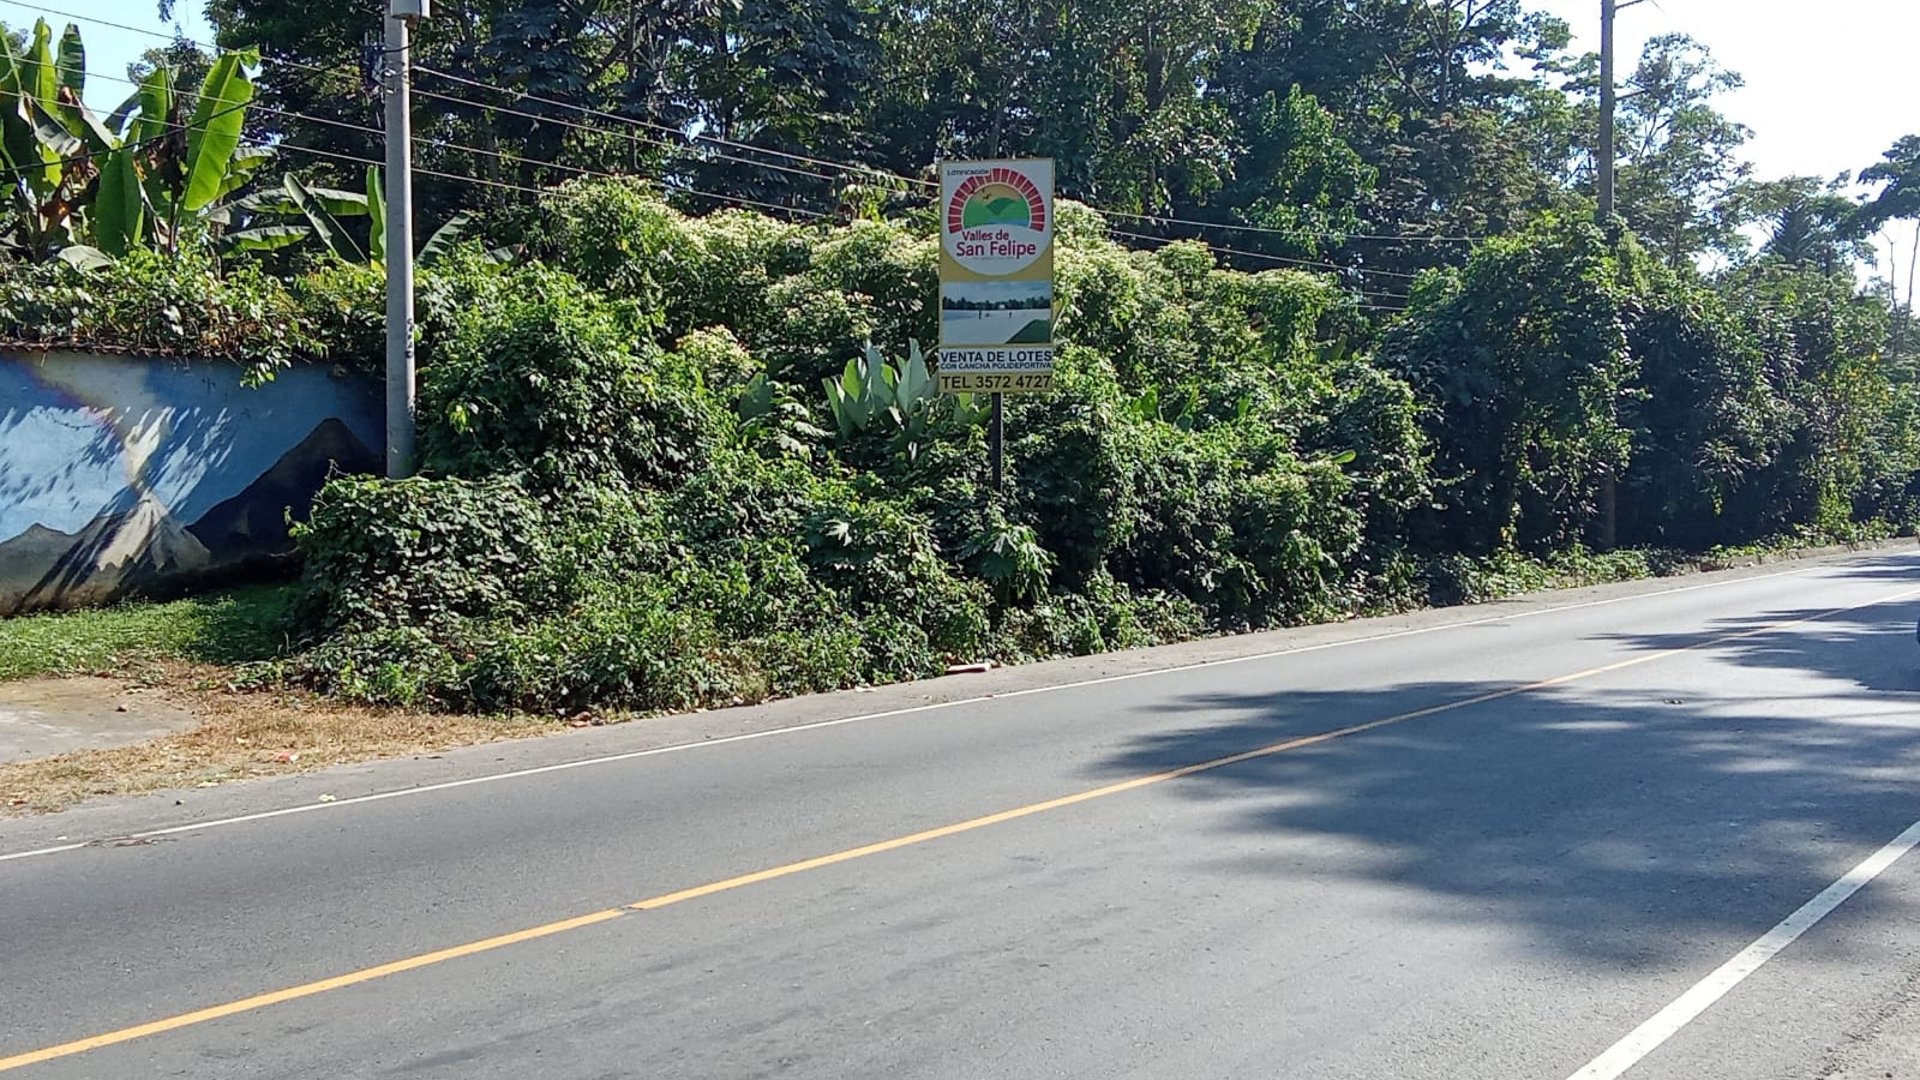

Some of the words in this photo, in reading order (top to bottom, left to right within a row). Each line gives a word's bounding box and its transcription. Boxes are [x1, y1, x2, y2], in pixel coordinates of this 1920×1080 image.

[962, 230, 993, 241] Valles
[995, 229, 1010, 241] de
[956, 242, 985, 257] San
[990, 240, 1036, 260] Felipe
[940, 351, 984, 362] VENTA
[987, 351, 1005, 362] DE
[1008, 350, 1053, 362] LOTES
[940, 362, 957, 370] CON
[958, 362, 991, 370] CANCHA
[941, 376, 971, 389] TEL
[975, 375, 1012, 389] 3572
[1015, 375, 1051, 388] 4727
